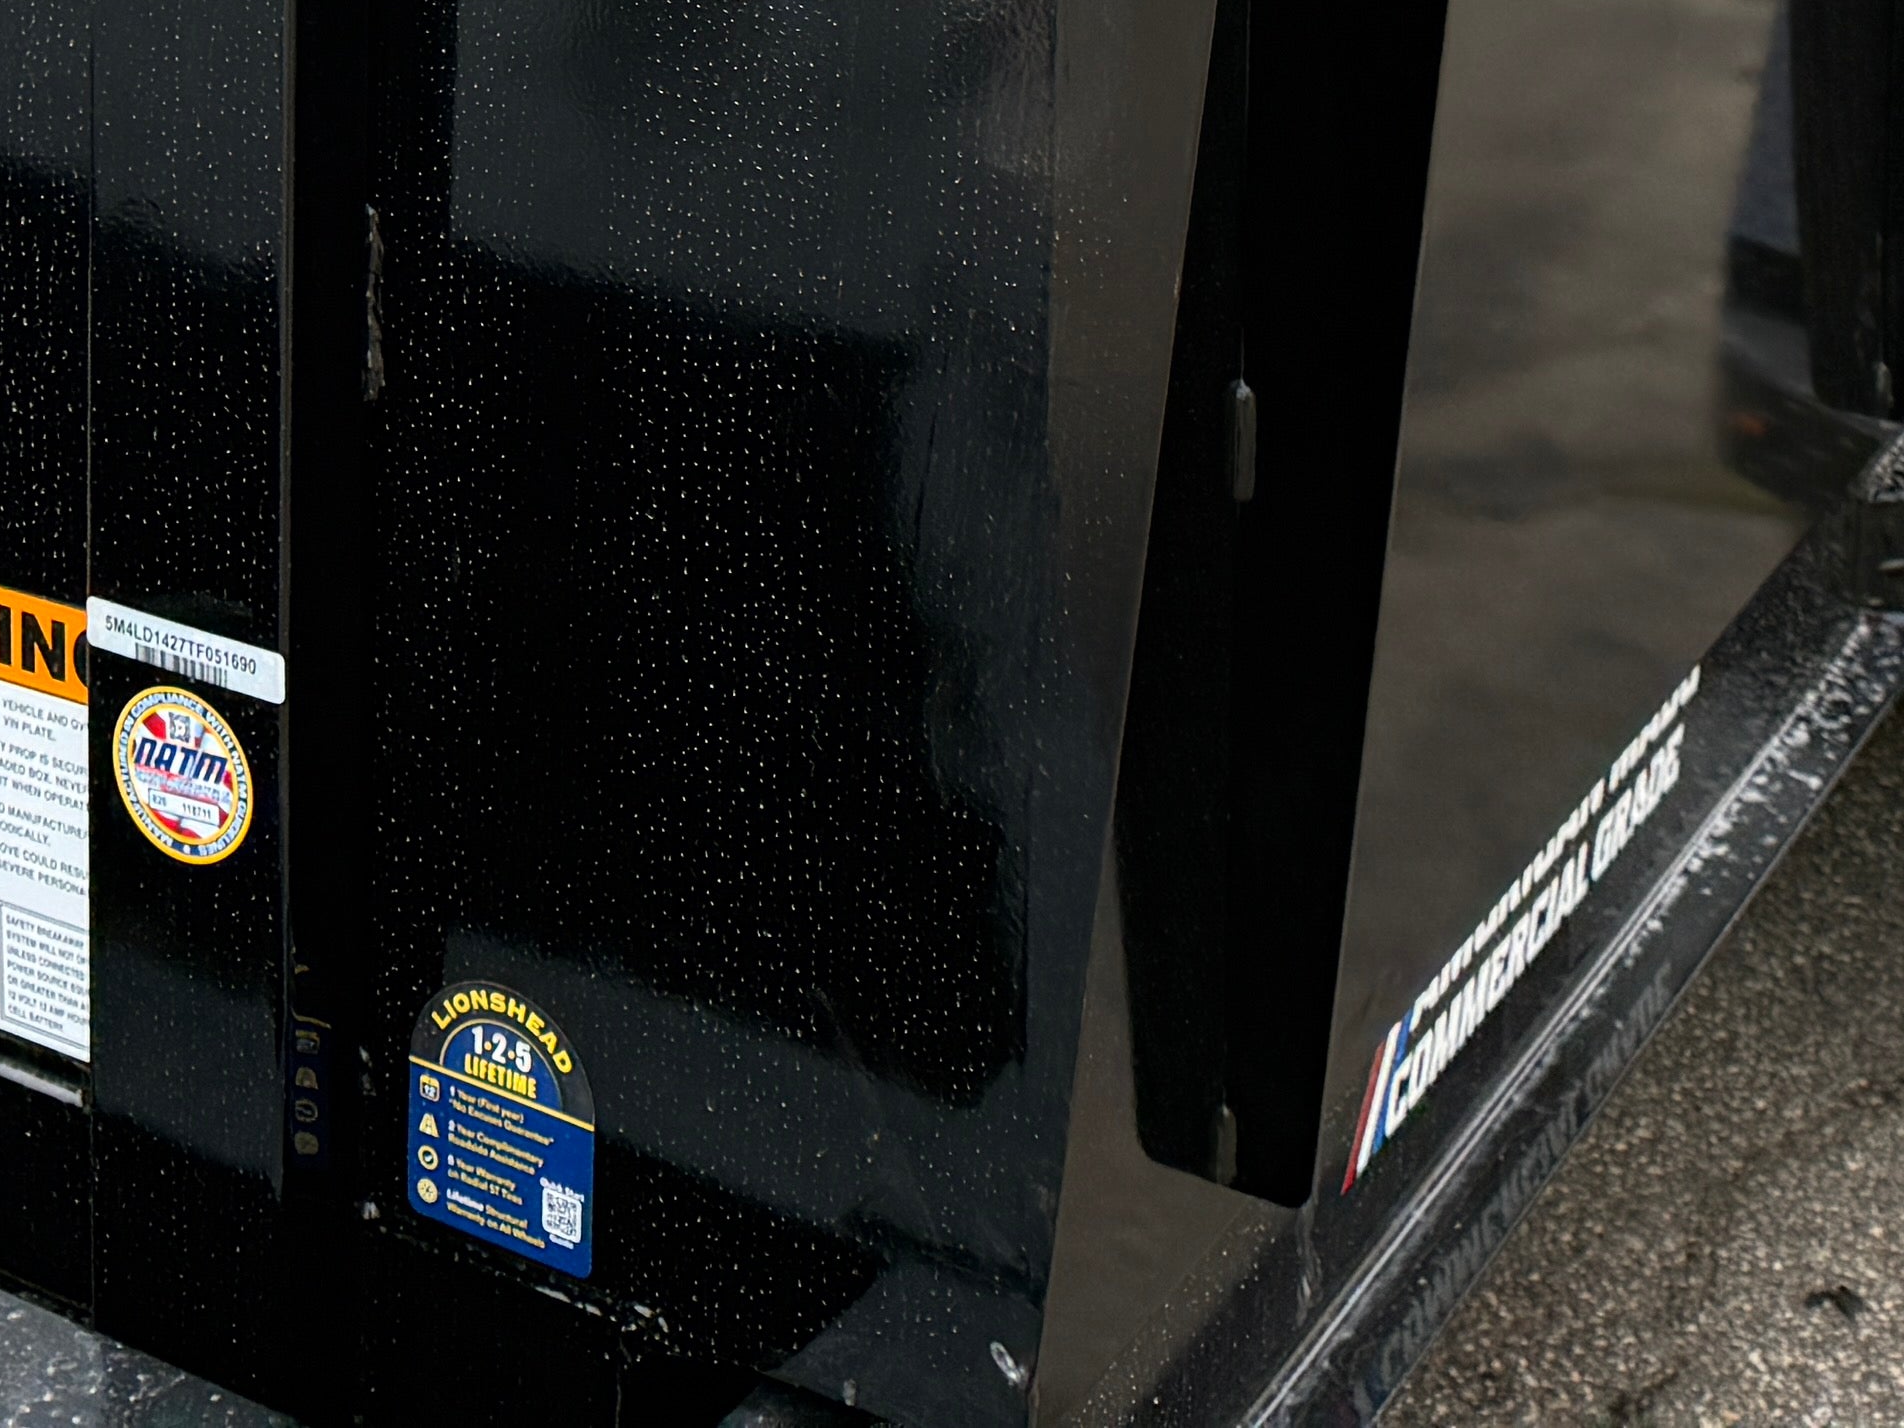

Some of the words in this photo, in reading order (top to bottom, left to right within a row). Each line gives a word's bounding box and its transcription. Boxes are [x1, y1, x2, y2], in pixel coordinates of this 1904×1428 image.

[129, 691, 203, 720] COMPLIANCE
[1385, 841, 1590, 1139] COMMERCIAL
[431, 989, 573, 1074] LIONSHEAD
[464, 1053, 537, 1099] LIFETIME
